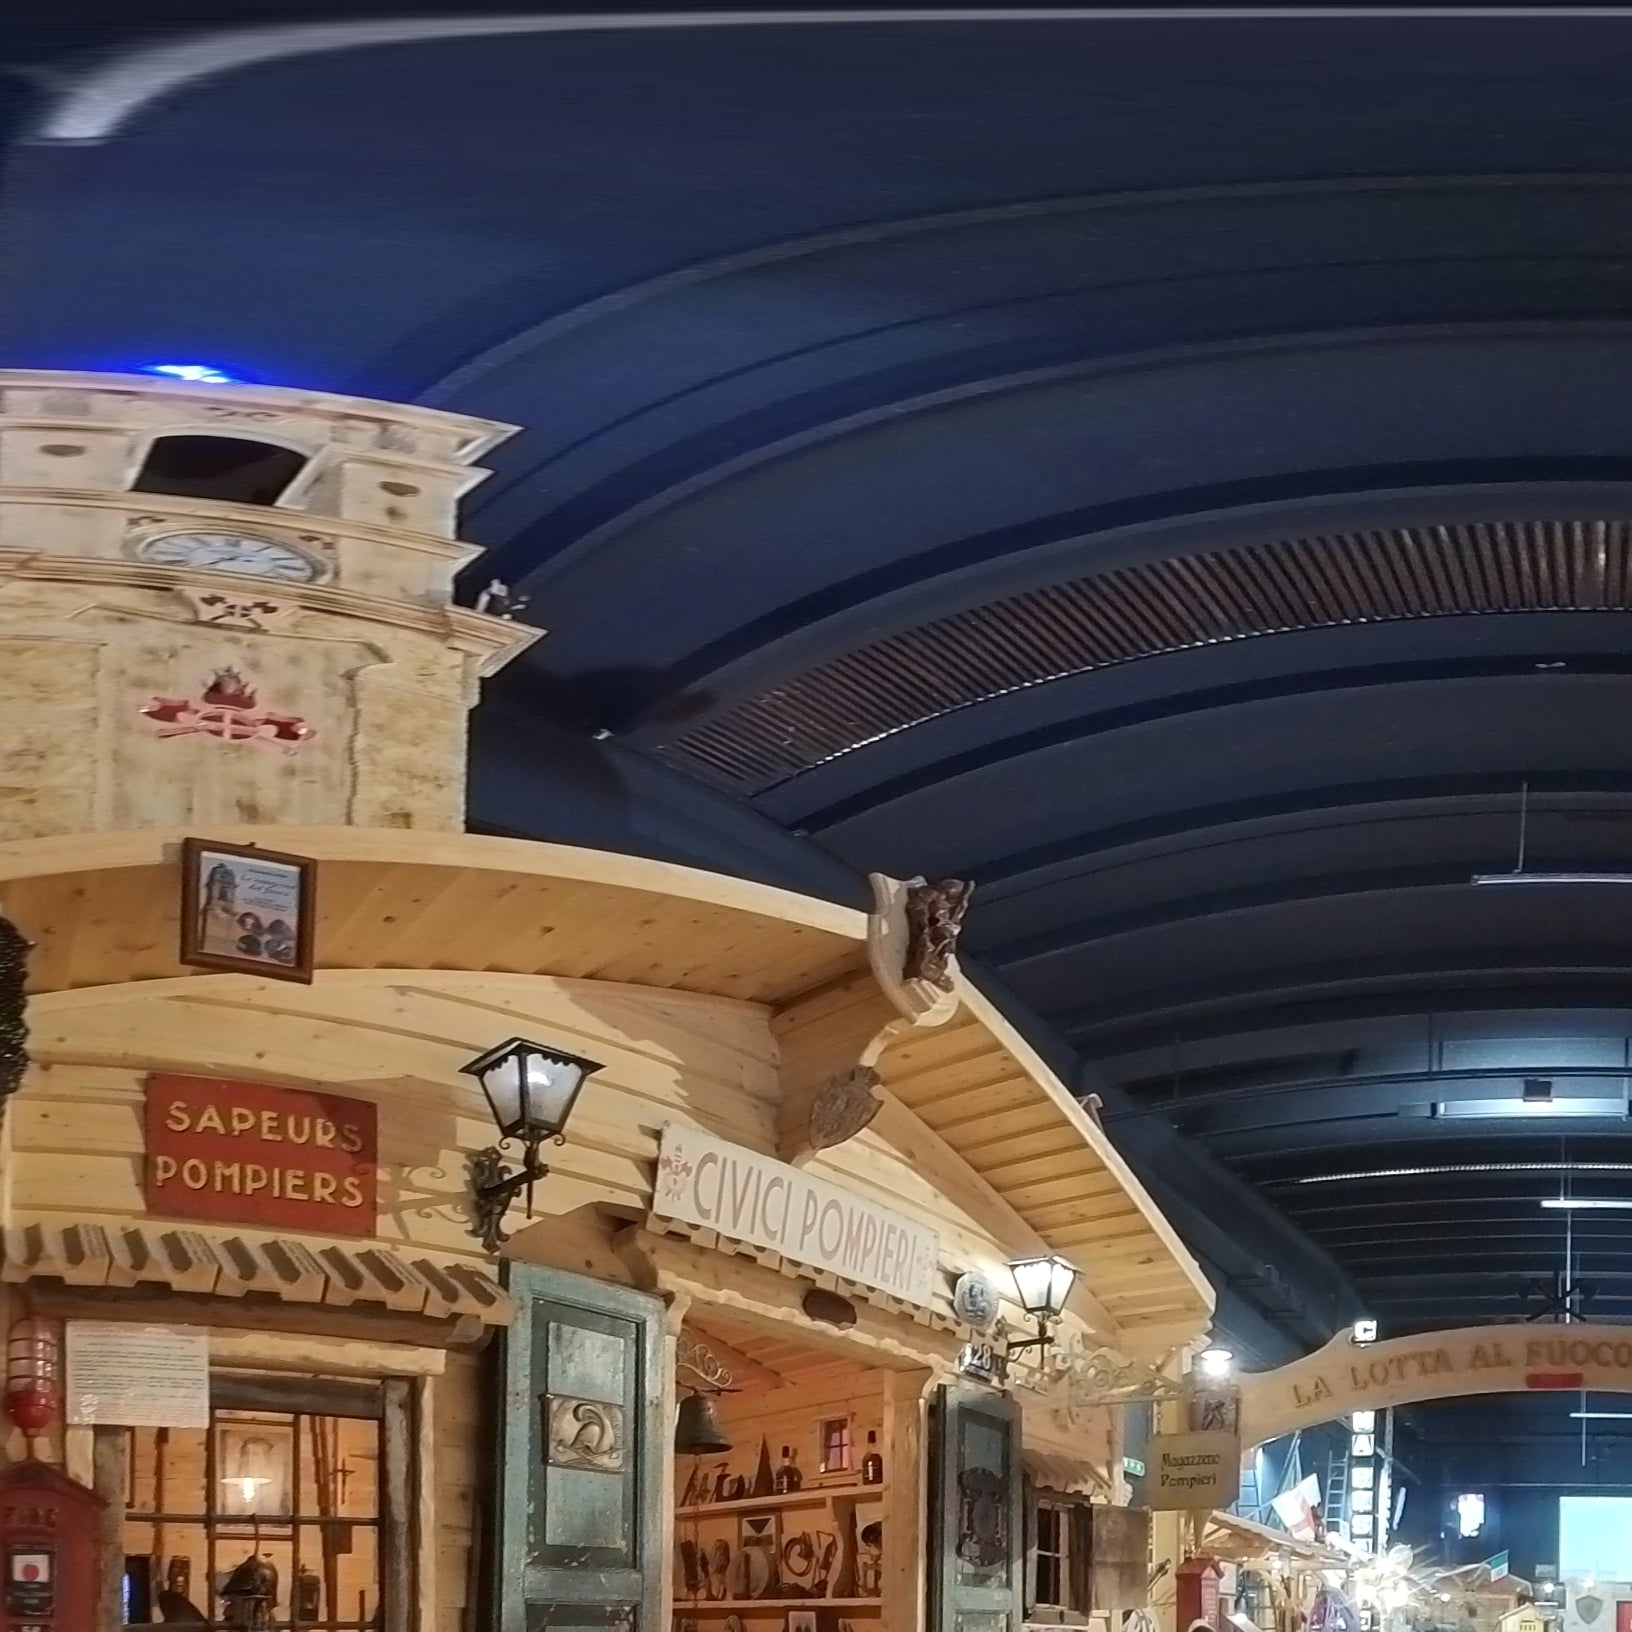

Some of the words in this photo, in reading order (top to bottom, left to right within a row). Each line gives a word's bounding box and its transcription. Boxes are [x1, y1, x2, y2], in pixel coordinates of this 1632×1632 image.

[166, 1100, 363, 1153] SAPEURS
[156, 1155, 364, 1208] POMPIERS
[693, 1152, 792, 1245] CIVICI
[800, 1188, 917, 1292] POMPIERI
[1293, 1375, 1331, 1408] LA
[1350, 1349, 1454, 1390] LOTTA
[1469, 1346, 1512, 1369] AL
[1161, 1472, 1217, 1490] Pompieri
